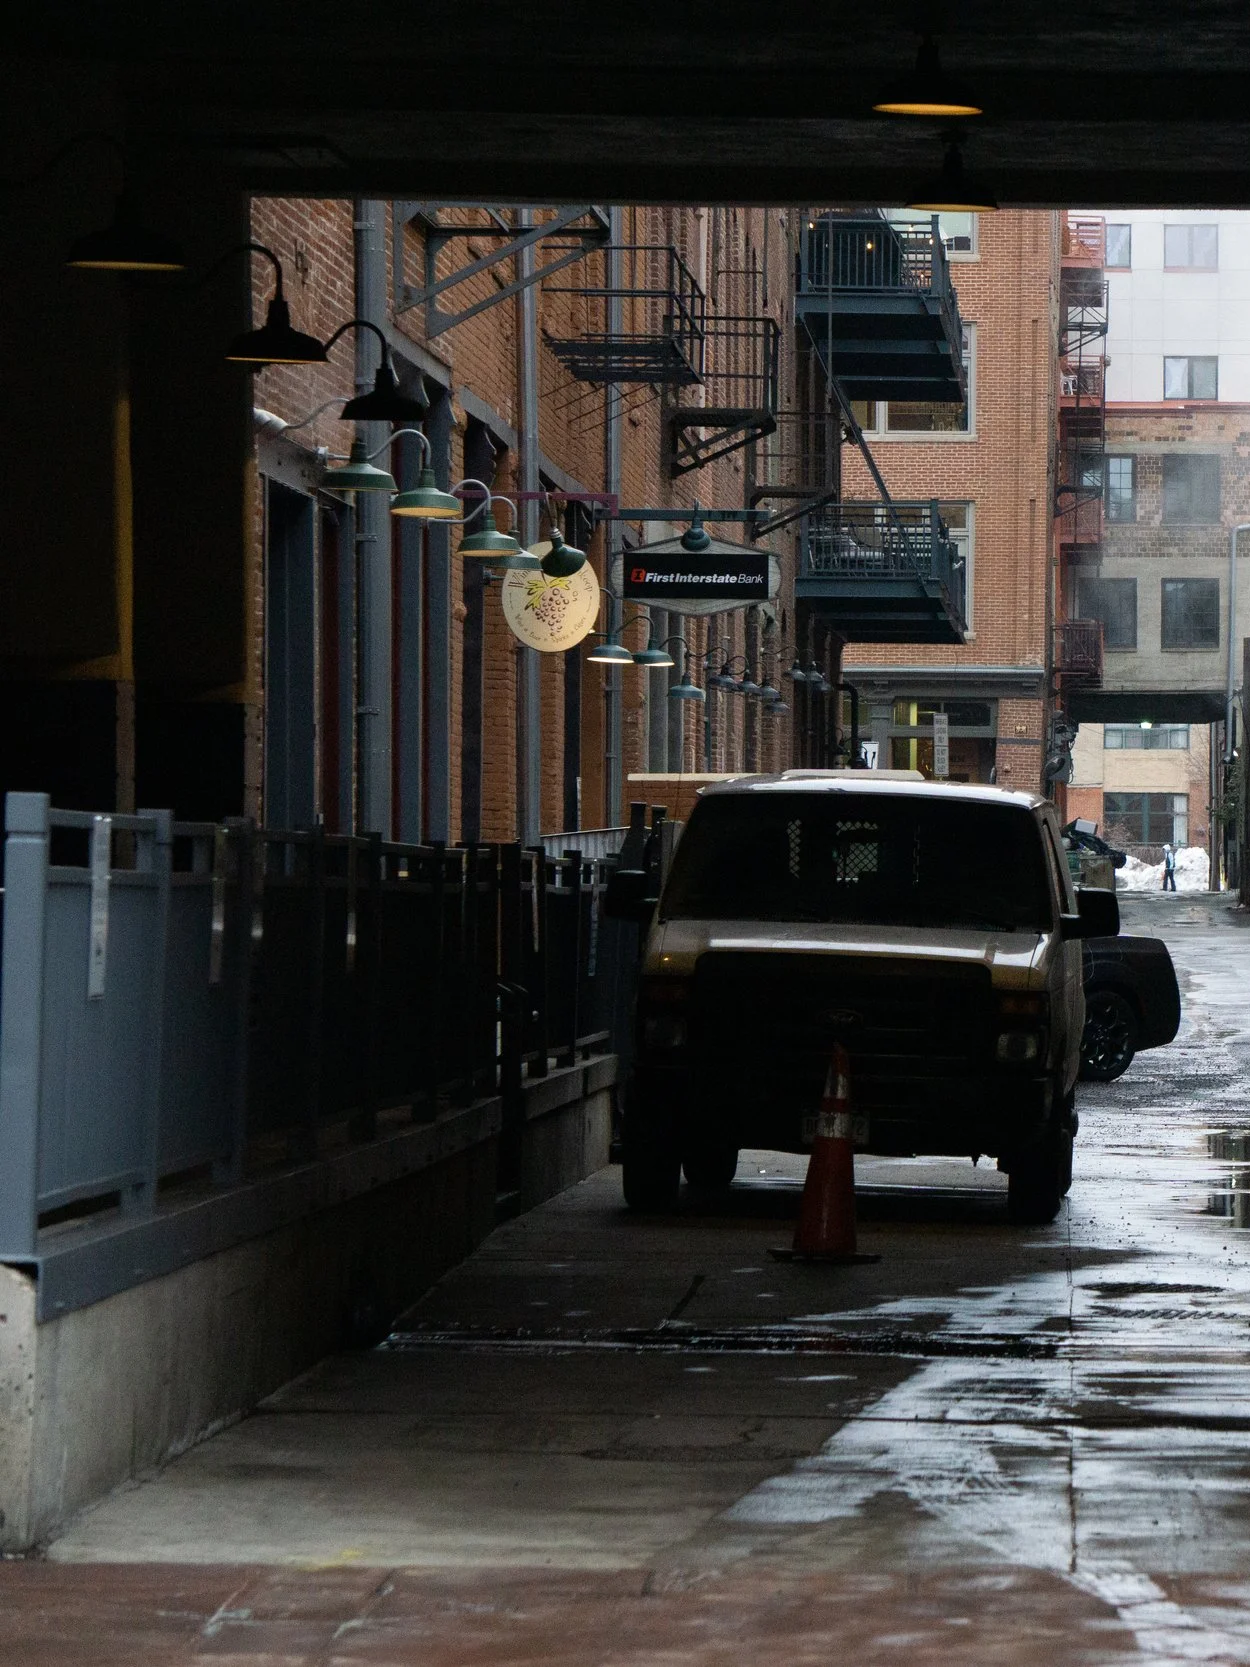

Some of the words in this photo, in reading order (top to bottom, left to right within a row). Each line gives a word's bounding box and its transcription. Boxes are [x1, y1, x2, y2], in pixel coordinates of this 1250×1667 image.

[645, 572, 675, 583] First
[675, 572, 737, 583] Interstate
[737, 573, 764, 584] Bank
